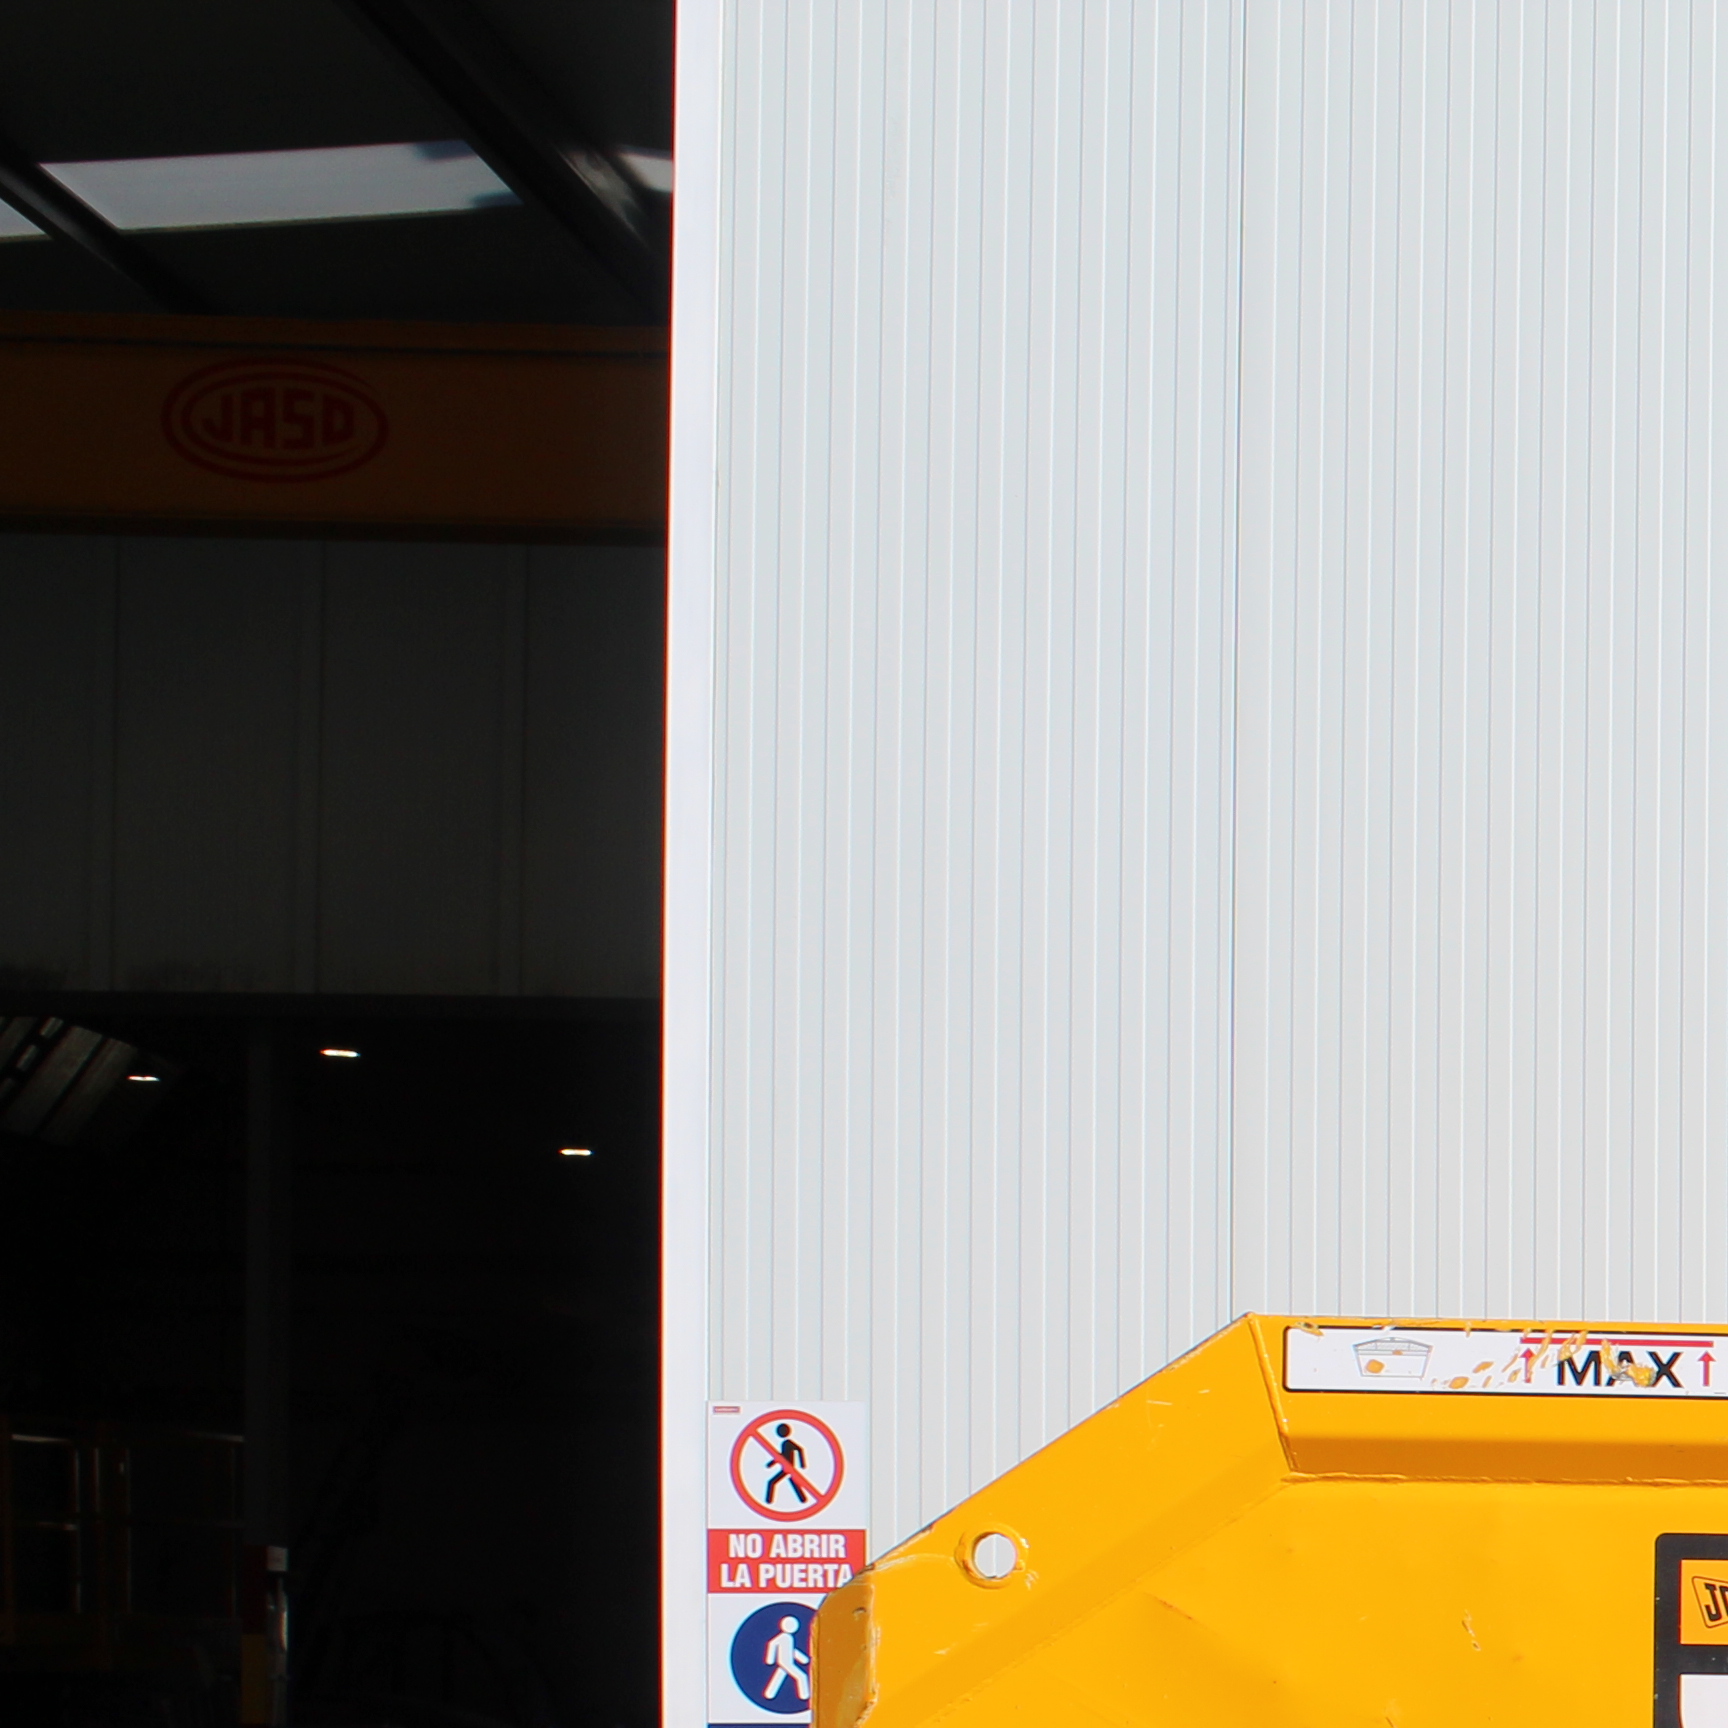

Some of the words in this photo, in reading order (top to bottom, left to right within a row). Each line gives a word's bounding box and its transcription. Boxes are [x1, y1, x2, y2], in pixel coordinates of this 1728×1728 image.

[201, 387, 354, 449] JASO
[728, 1533, 766, 1558] NO
[769, 1533, 846, 1558] ABRIR
[720, 1563, 753, 1588] LA
[758, 1564, 854, 1588] PUERTA
